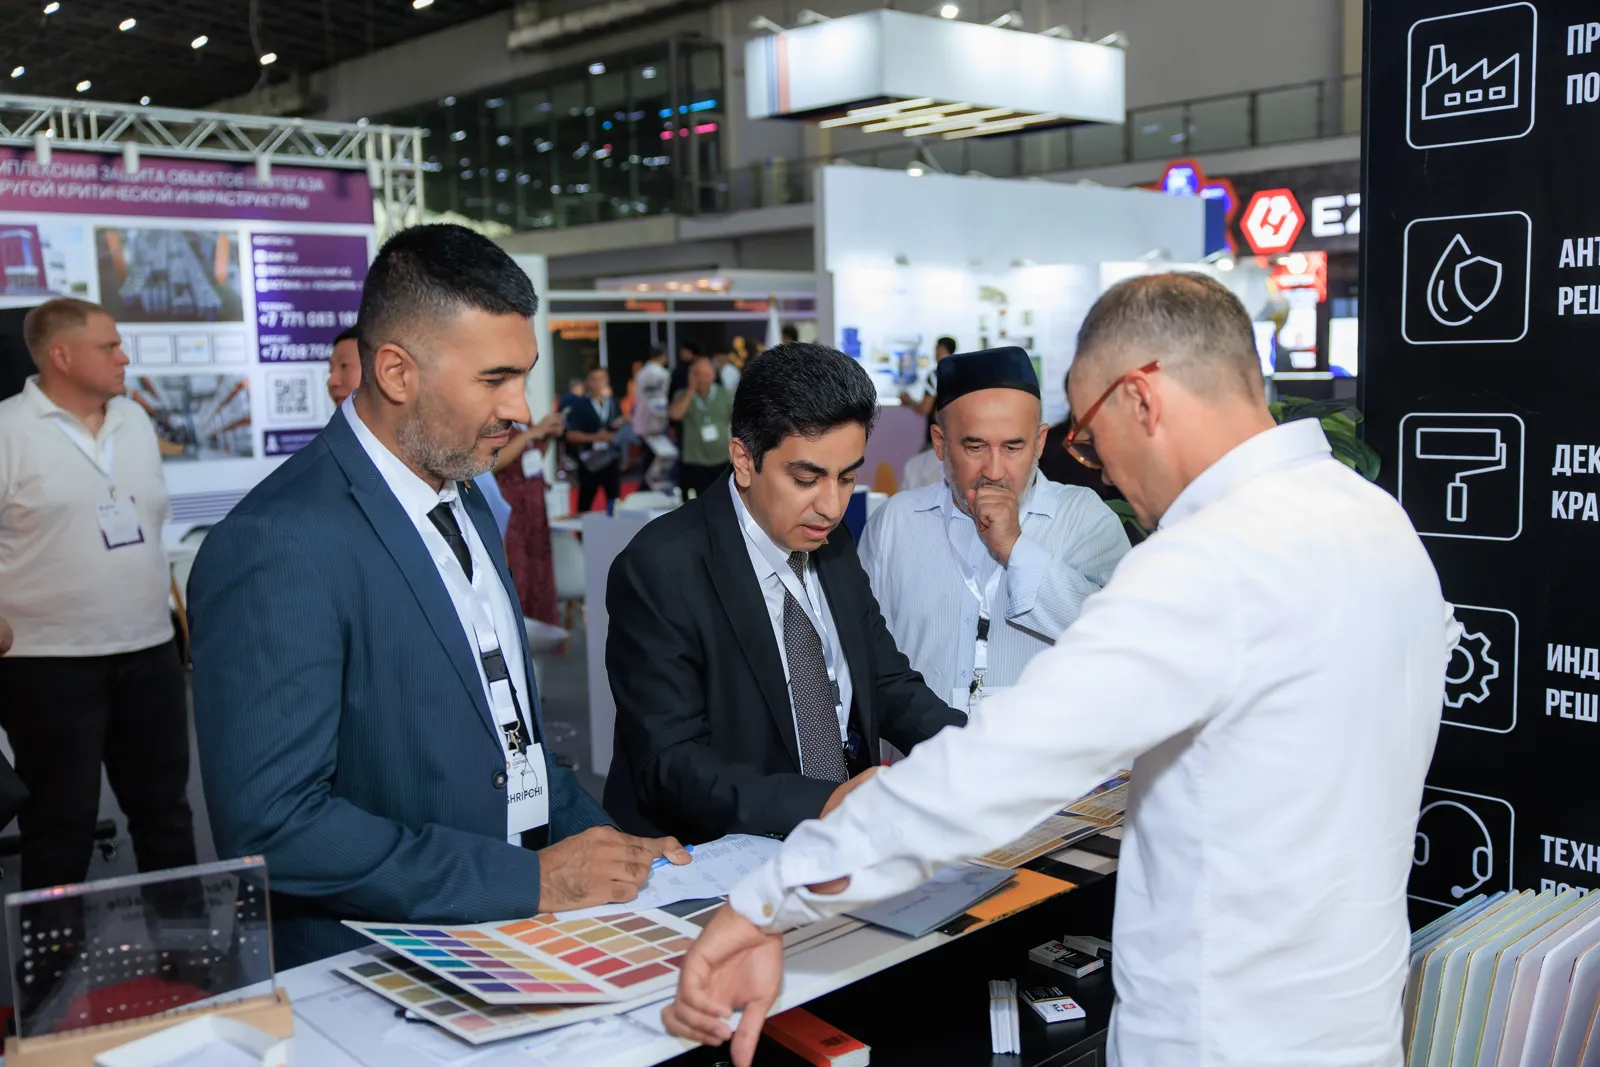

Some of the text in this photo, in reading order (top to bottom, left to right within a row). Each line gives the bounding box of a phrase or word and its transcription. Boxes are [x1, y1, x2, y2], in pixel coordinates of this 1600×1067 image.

[1566, 22, 1600, 56] ПР
[1566, 71, 1600, 106] ПО
[1551, 444, 1600, 477] ДЕК
[1551, 490, 1599, 522] КРА
[1546, 642, 1600, 681] ИНД
[1545, 687, 1599, 723] РЕШ
[1540, 834, 1600, 874] ТЕХН
